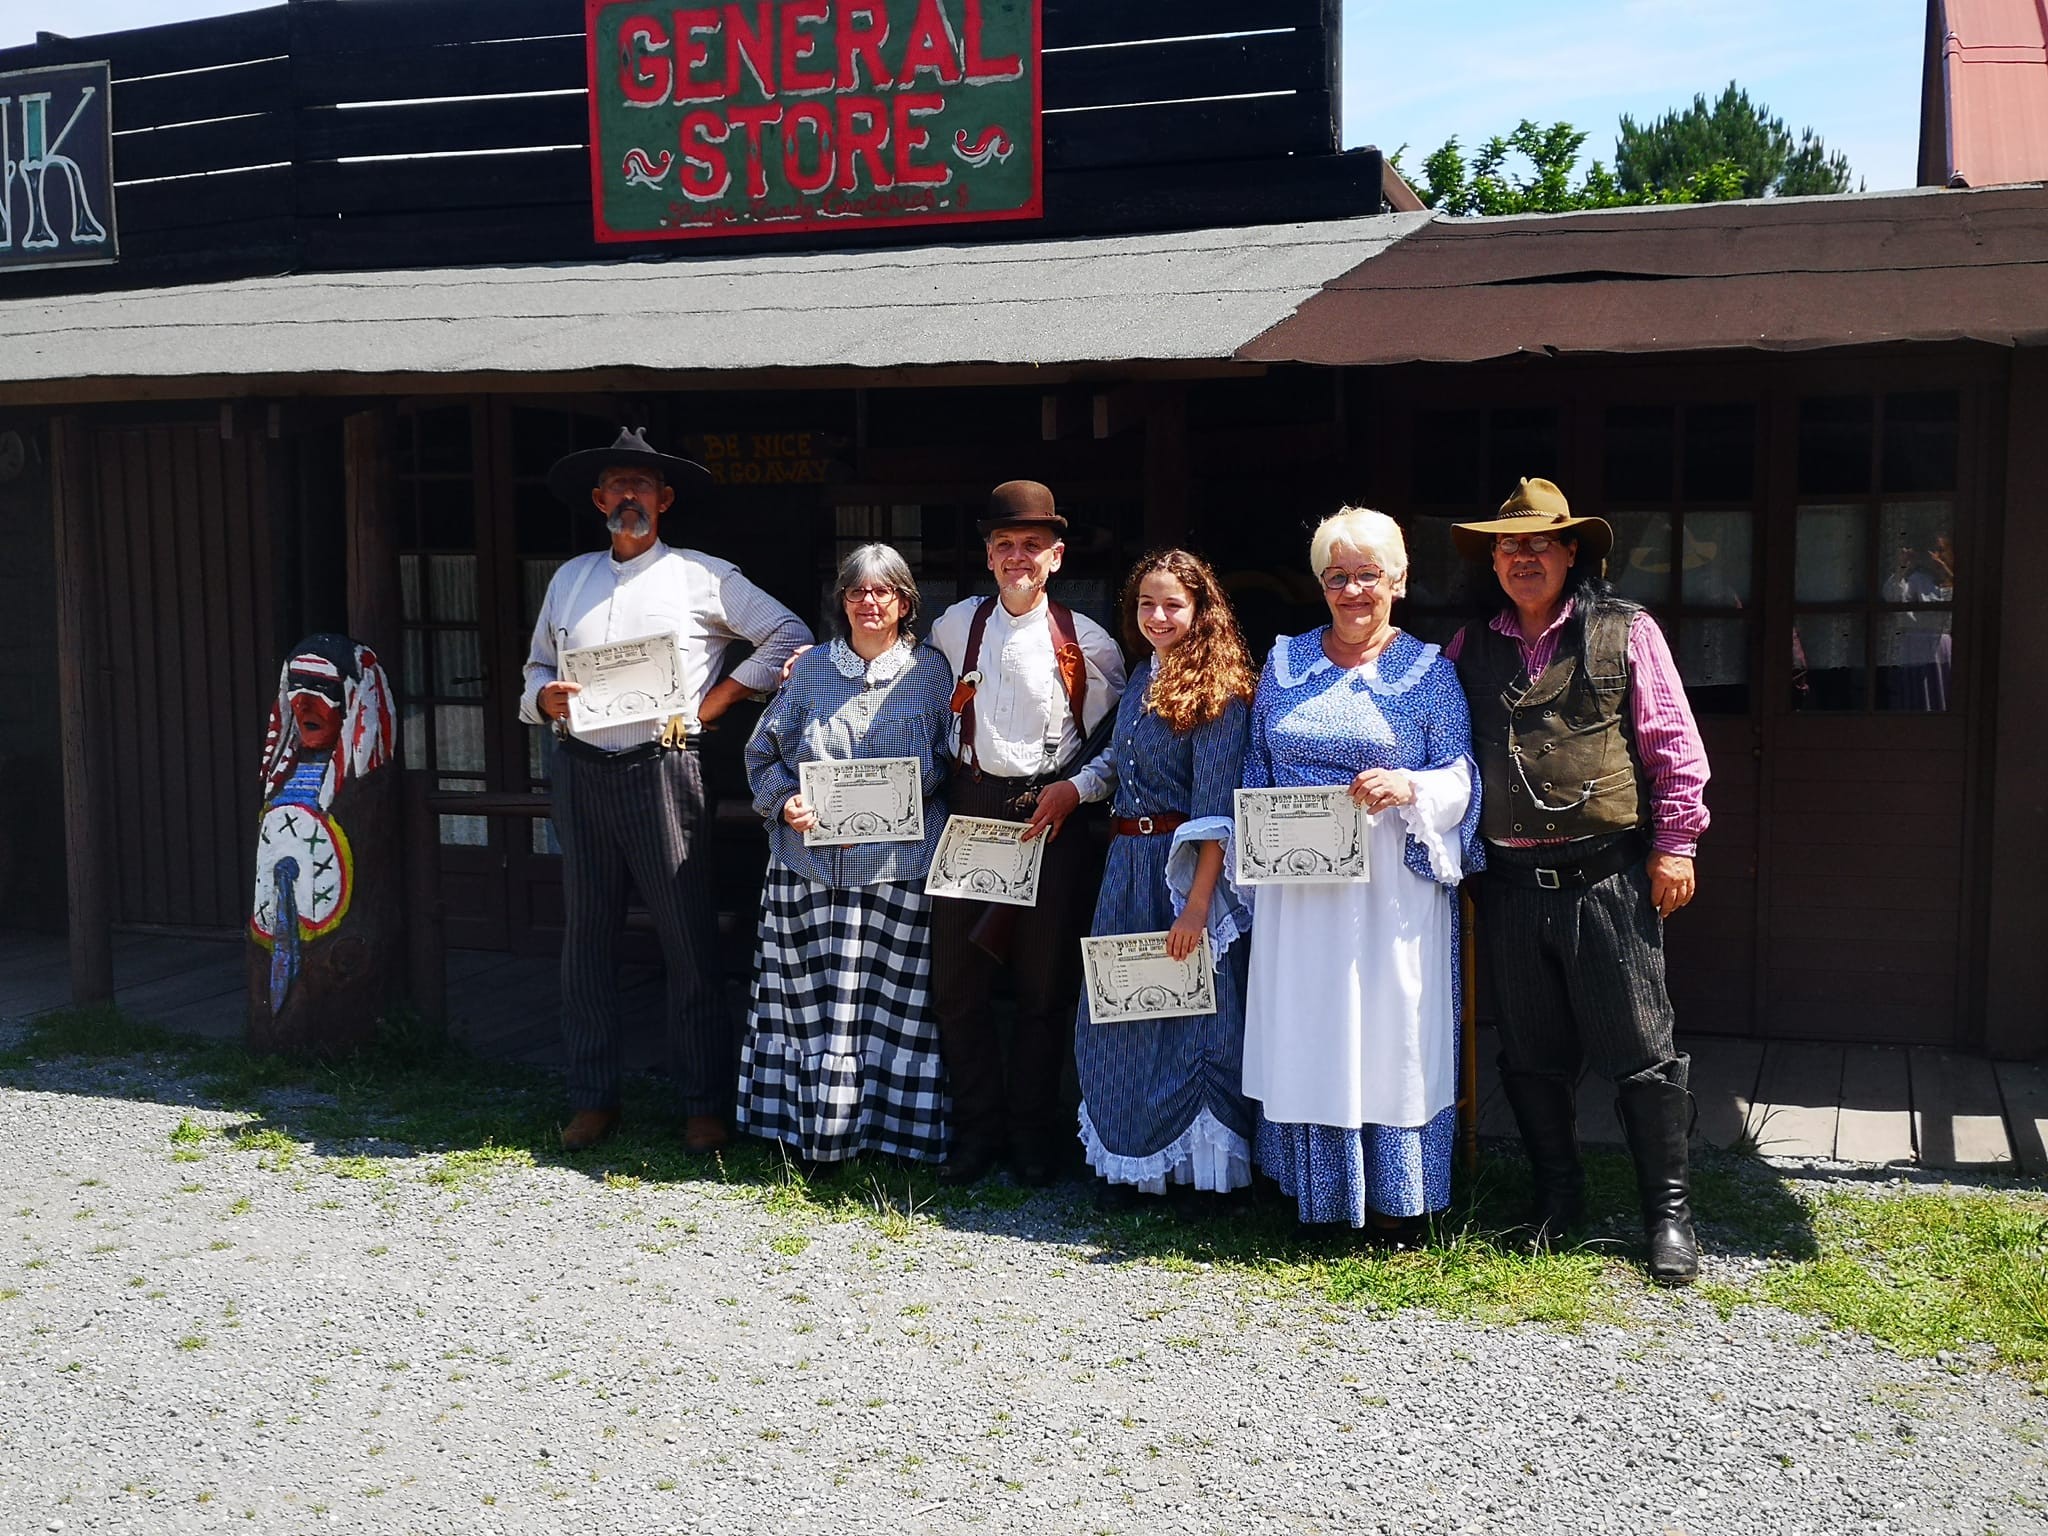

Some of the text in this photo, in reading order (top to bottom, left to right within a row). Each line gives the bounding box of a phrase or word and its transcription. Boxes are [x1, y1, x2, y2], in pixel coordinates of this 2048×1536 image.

[618, 0, 1024, 107] GENERAL
[0, 86, 106, 248] K
[679, 93, 953, 202] STORE
[704, 432, 812, 462] BE NICE
